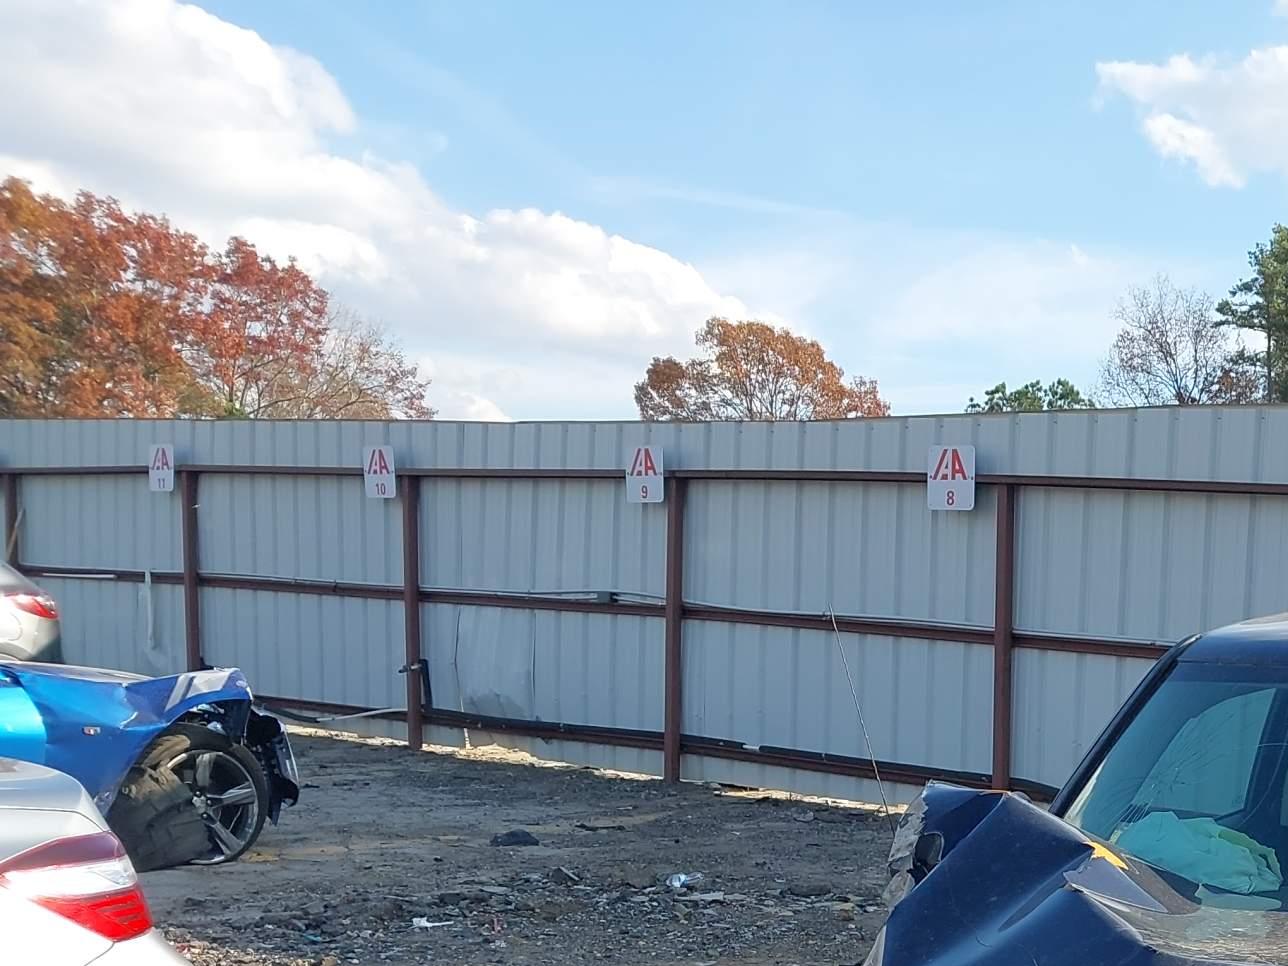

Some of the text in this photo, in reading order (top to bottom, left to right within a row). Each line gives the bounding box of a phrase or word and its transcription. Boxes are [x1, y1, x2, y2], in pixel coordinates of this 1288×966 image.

[157, 478, 166, 489] 11
[375, 482, 387, 496] 10
[641, 484, 649, 499] 9
[946, 490, 955, 506] 8
